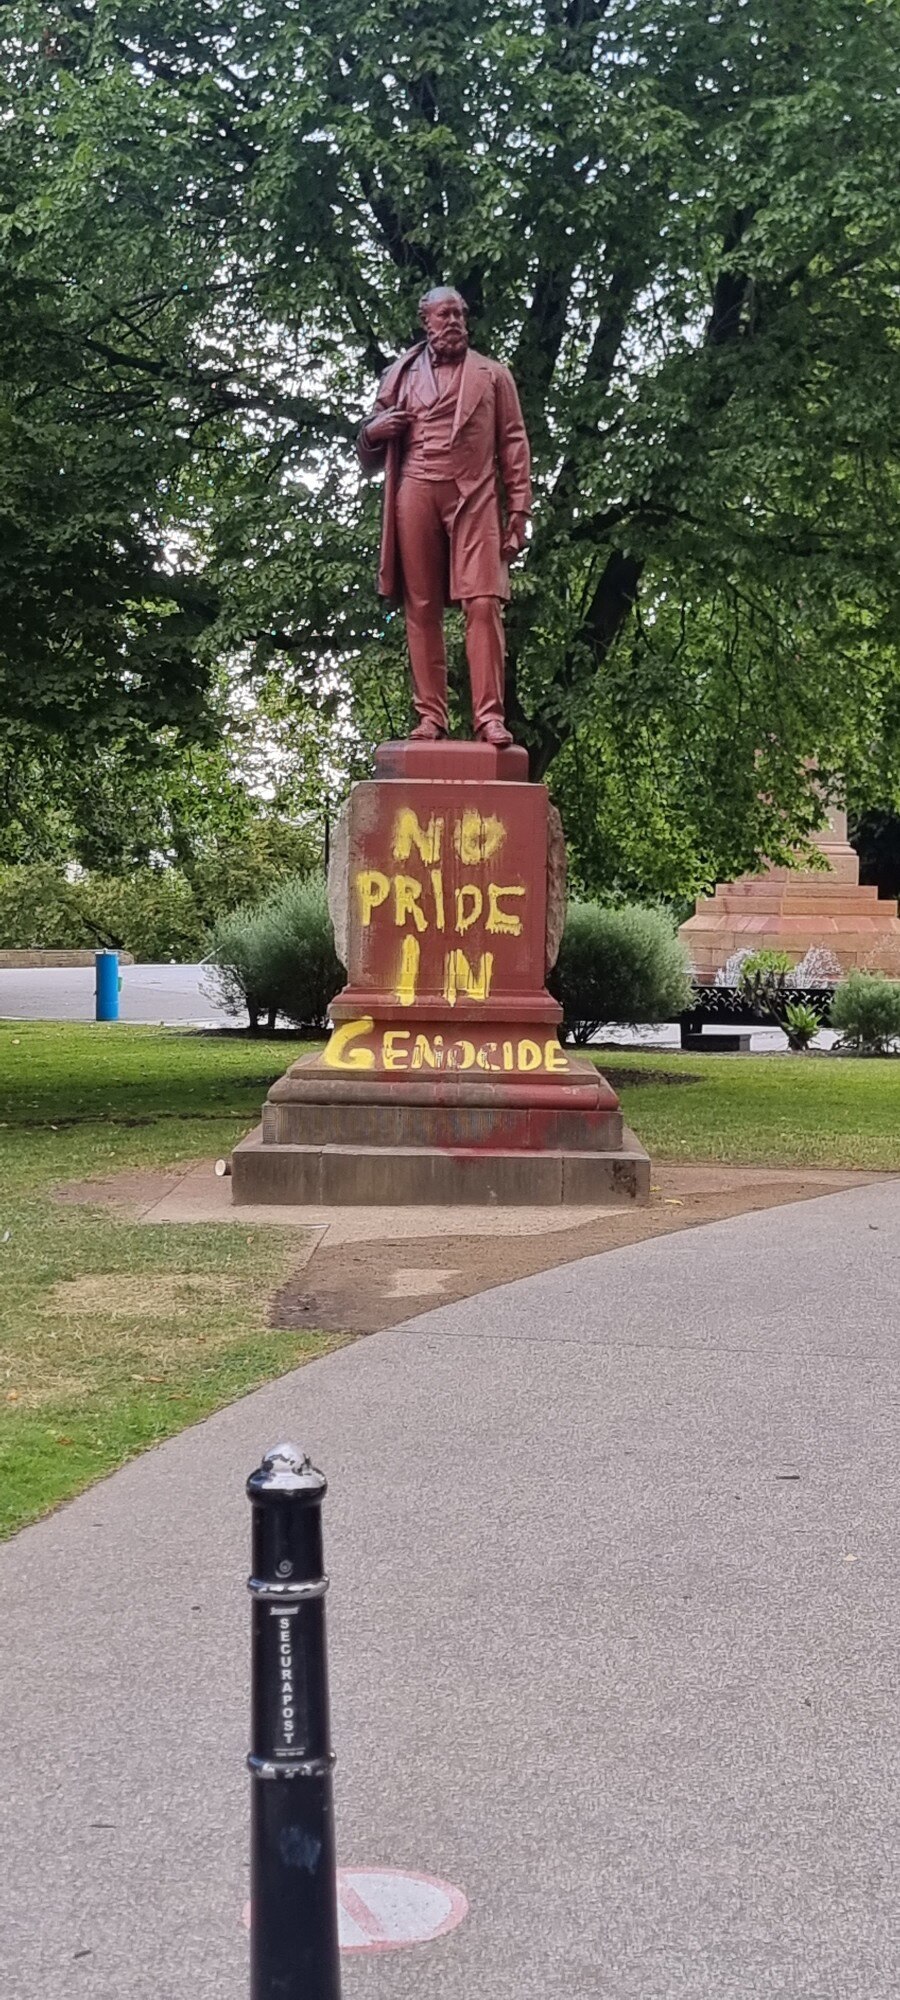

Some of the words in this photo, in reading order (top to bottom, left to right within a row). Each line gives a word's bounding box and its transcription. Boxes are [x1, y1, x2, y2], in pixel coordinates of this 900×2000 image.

[392, 806, 507, 866] NO
[357, 868, 525, 937] PRIDE
[396, 934, 494, 1007] IN
[323, 1015, 571, 1072] GENOCIDE
[279, 1617, 294, 1744] SECURAPOST
